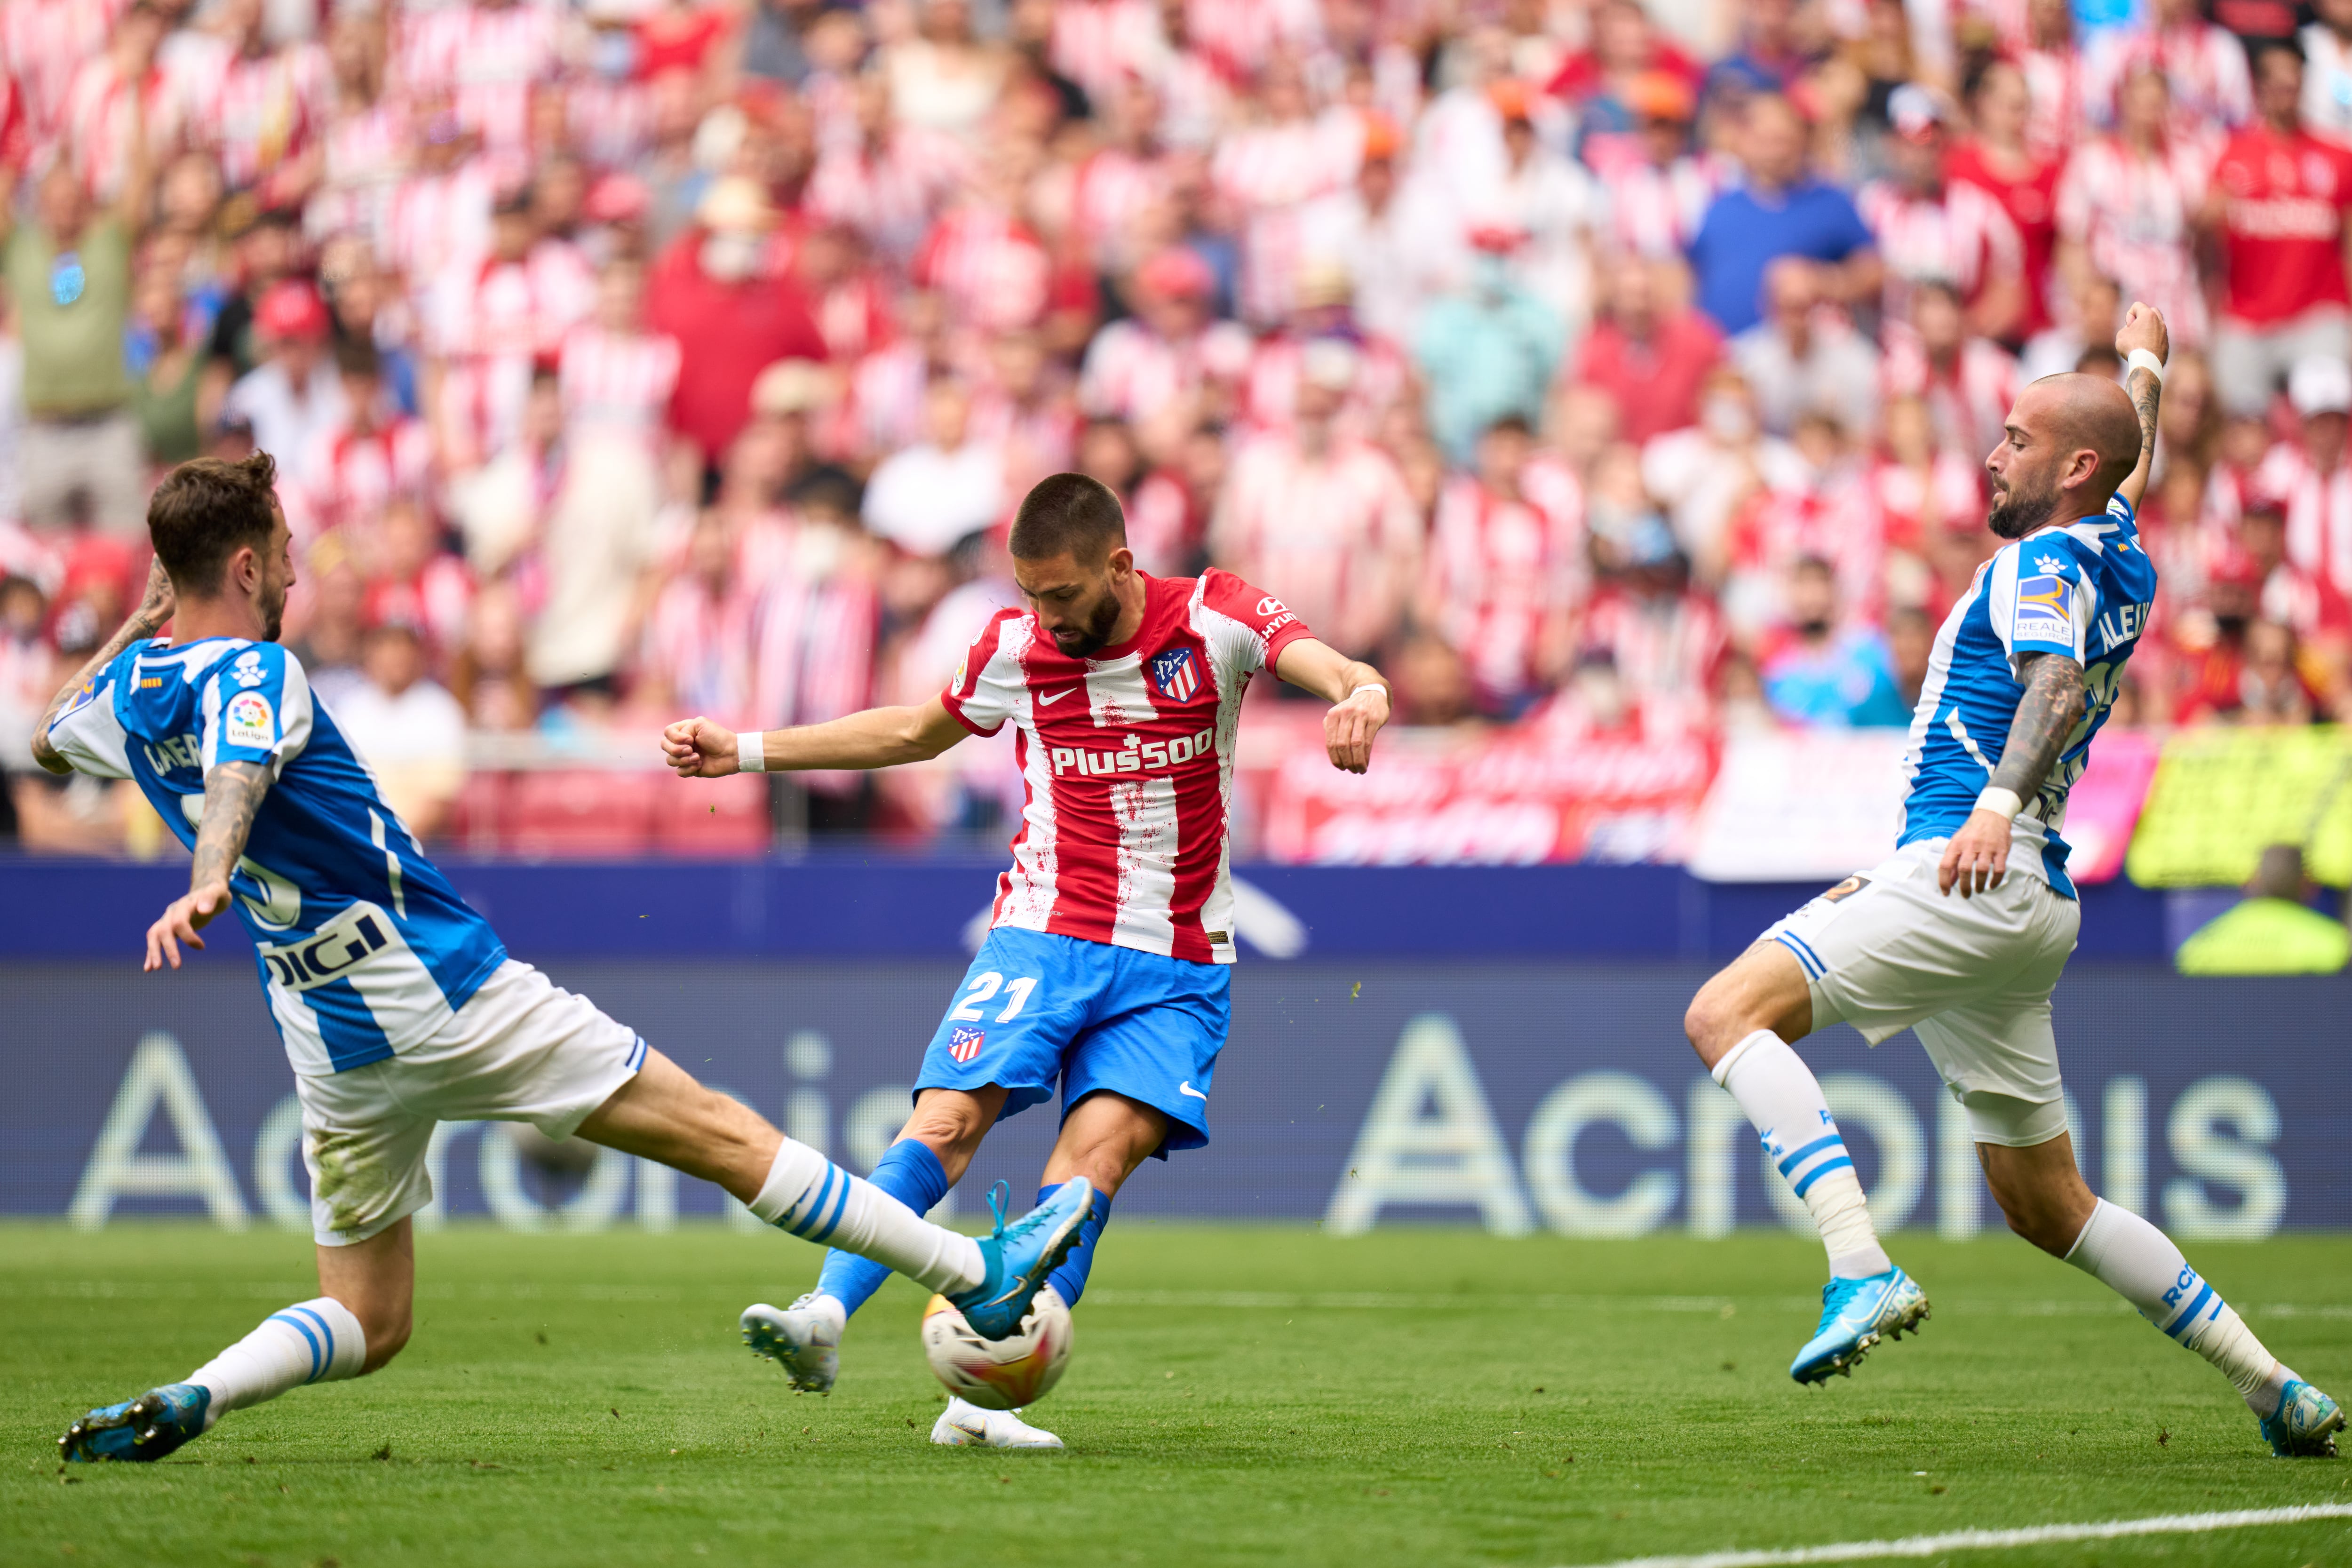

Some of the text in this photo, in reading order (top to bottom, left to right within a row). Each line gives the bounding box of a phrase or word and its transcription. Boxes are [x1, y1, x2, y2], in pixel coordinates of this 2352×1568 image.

[2017, 622, 2070, 636] REALE
[2016, 631, 2070, 644] SEGUROS
[232, 730, 269, 741] LaLiga
[1052, 727, 1213, 776] Plus500
[948, 971, 1038, 1023] 21
